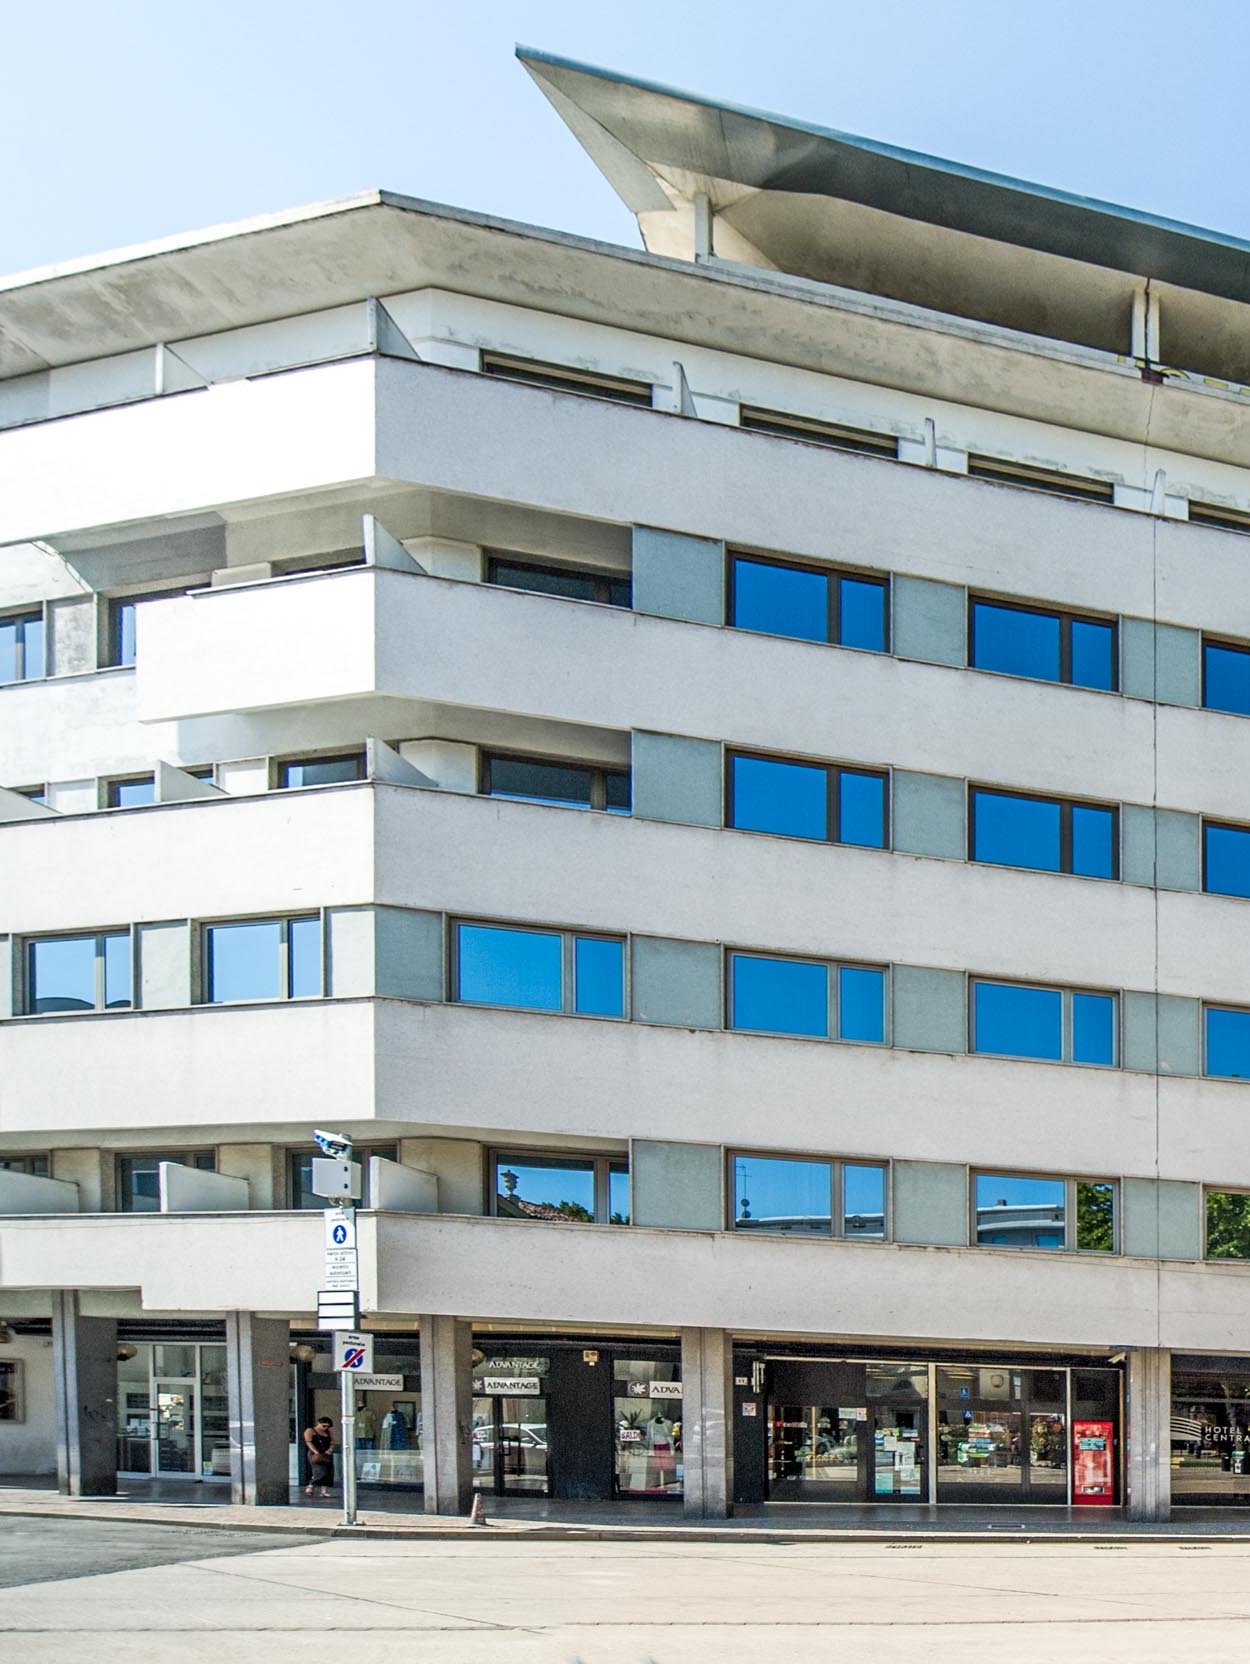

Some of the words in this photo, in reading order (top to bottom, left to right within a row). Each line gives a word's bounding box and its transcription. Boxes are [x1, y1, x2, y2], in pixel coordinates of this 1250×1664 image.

[488, 1360, 540, 1369] ADVANTAGE
[354, 1378, 402, 1386] ADVANTAGE
[486, 1381, 538, 1390] ADVANTAGE
[651, 1385, 683, 1394] ADVA
[1204, 1426, 1242, 1435] HOTEL
